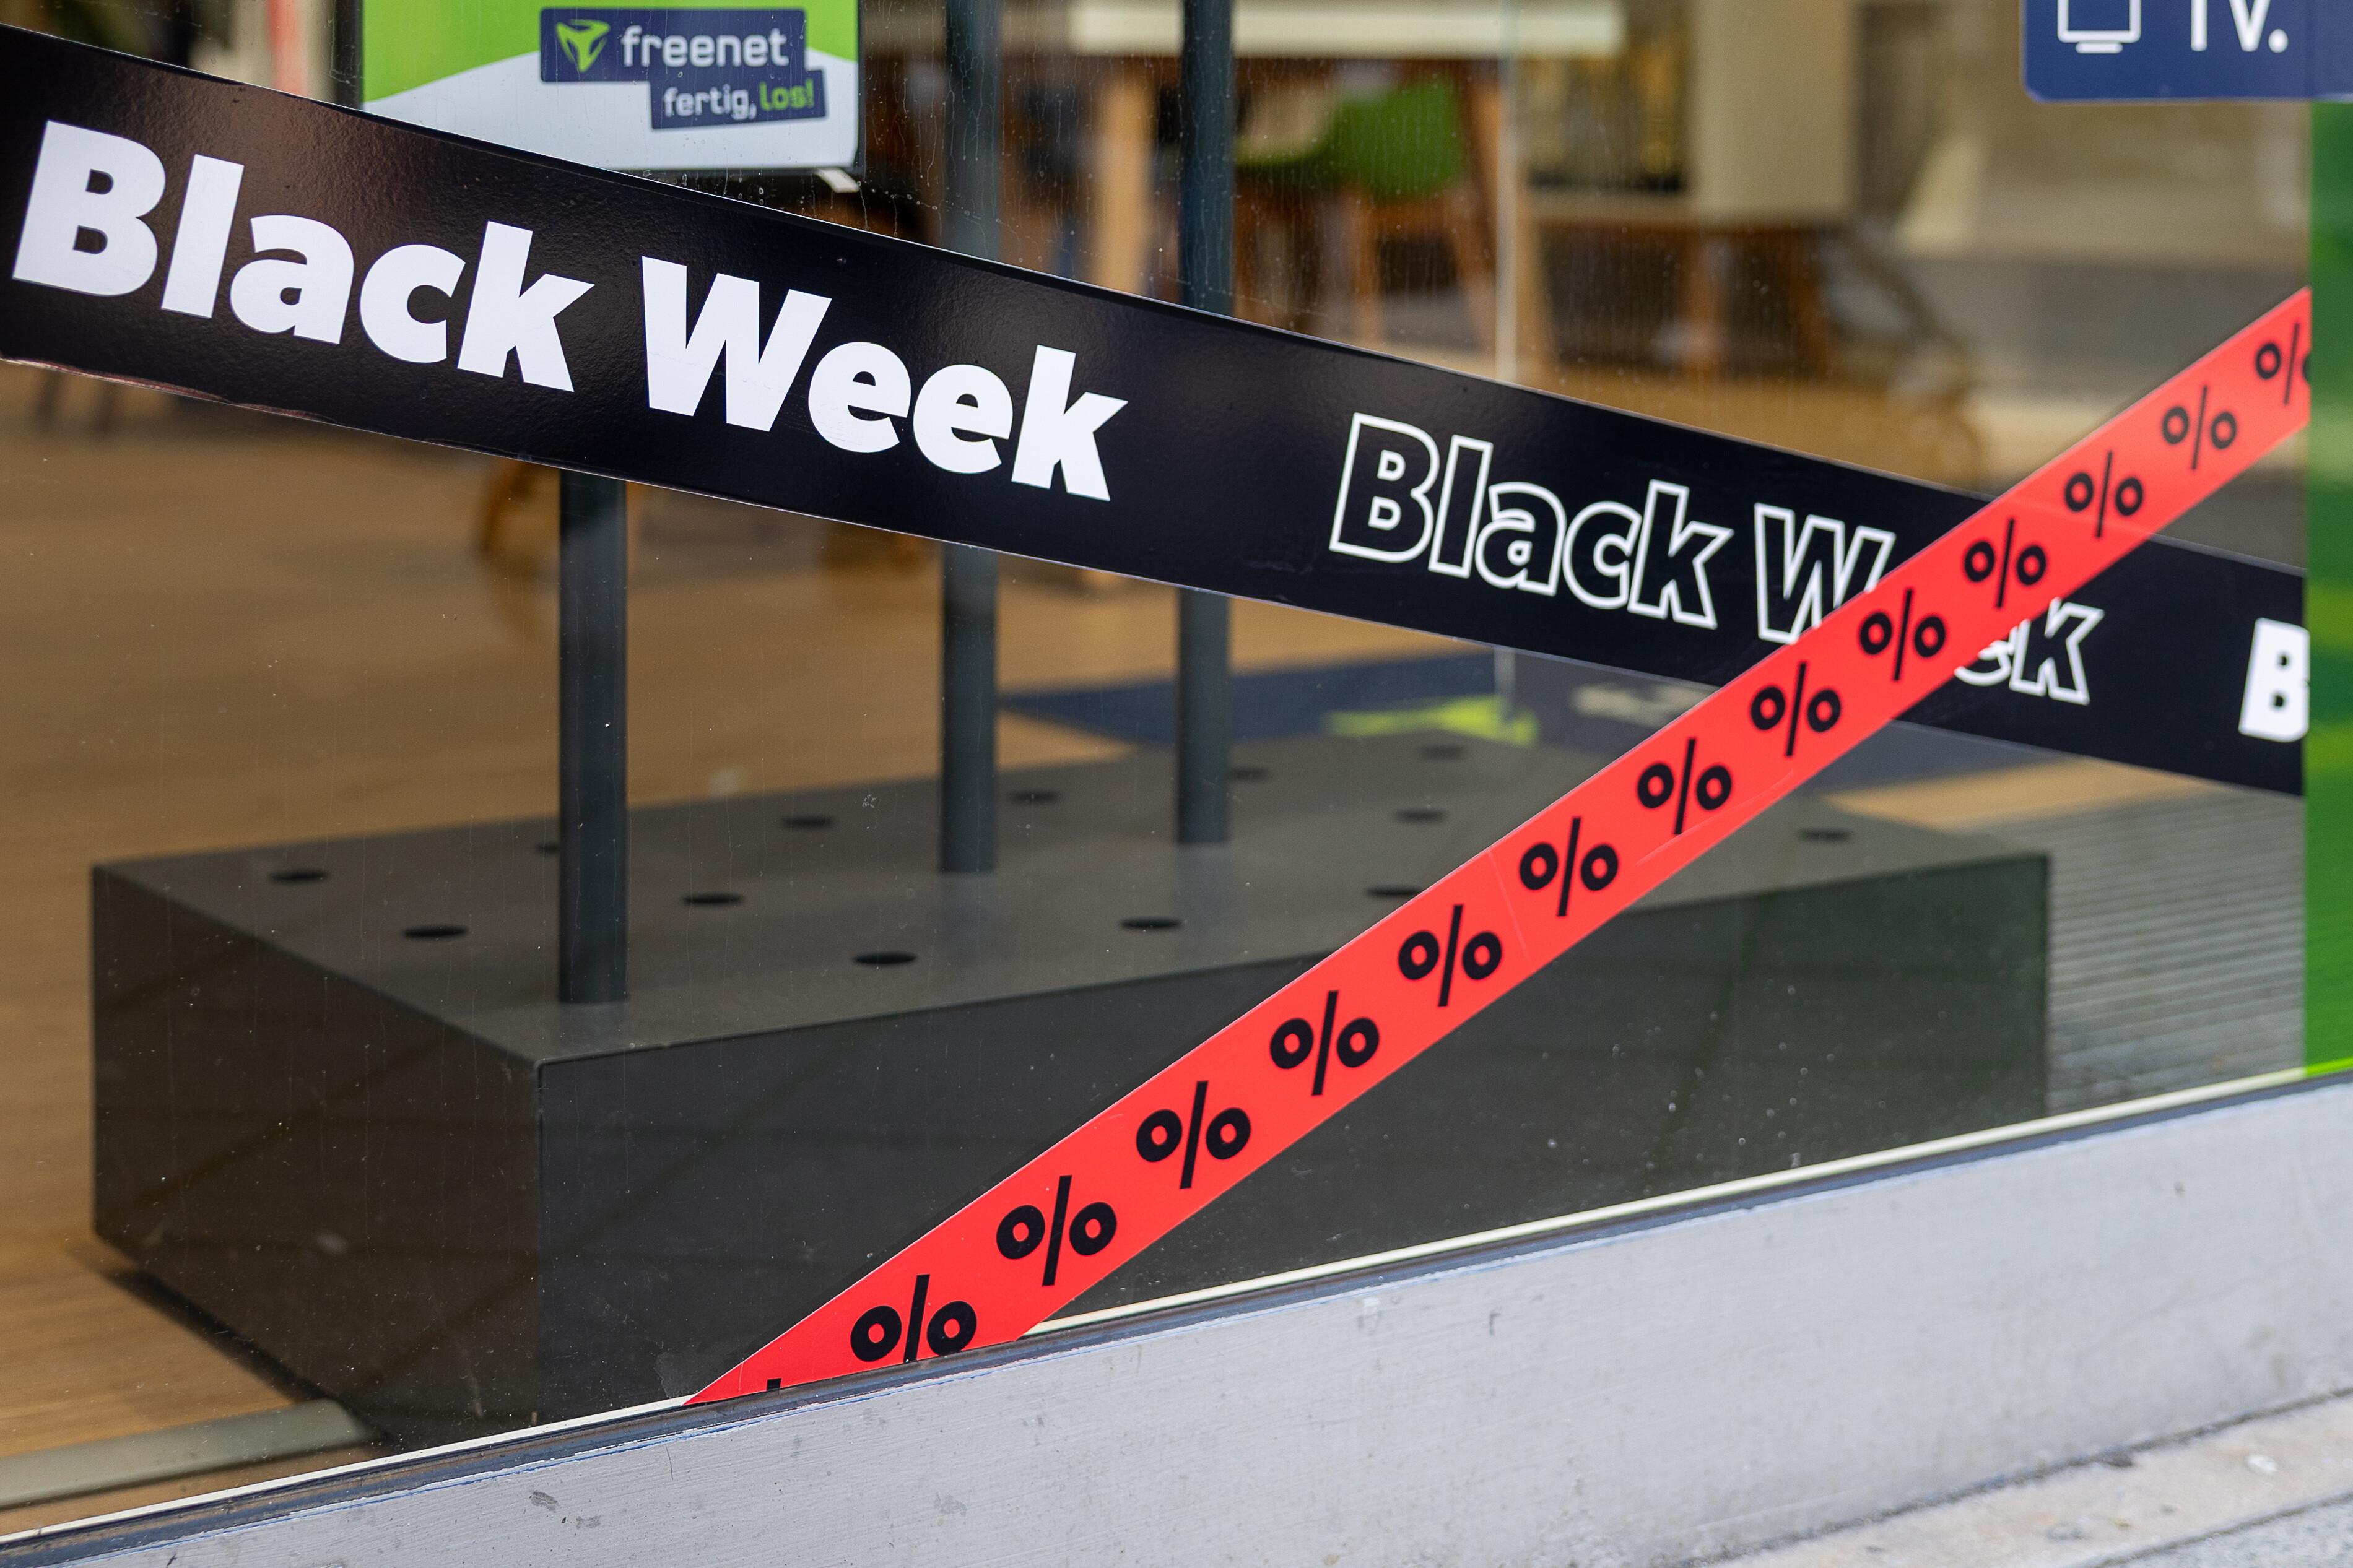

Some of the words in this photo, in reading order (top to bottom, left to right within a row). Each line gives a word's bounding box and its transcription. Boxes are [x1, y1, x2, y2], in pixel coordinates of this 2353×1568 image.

[621, 25, 789, 67] freenet
[663, 84, 757, 120] fertig,
[759, 79, 814, 111] los!
[12, 121, 596, 393] Black
[642, 256, 1128, 502] Week
[1329, 412, 1734, 630] Black
[1755, 503, 2104, 706] Wk
